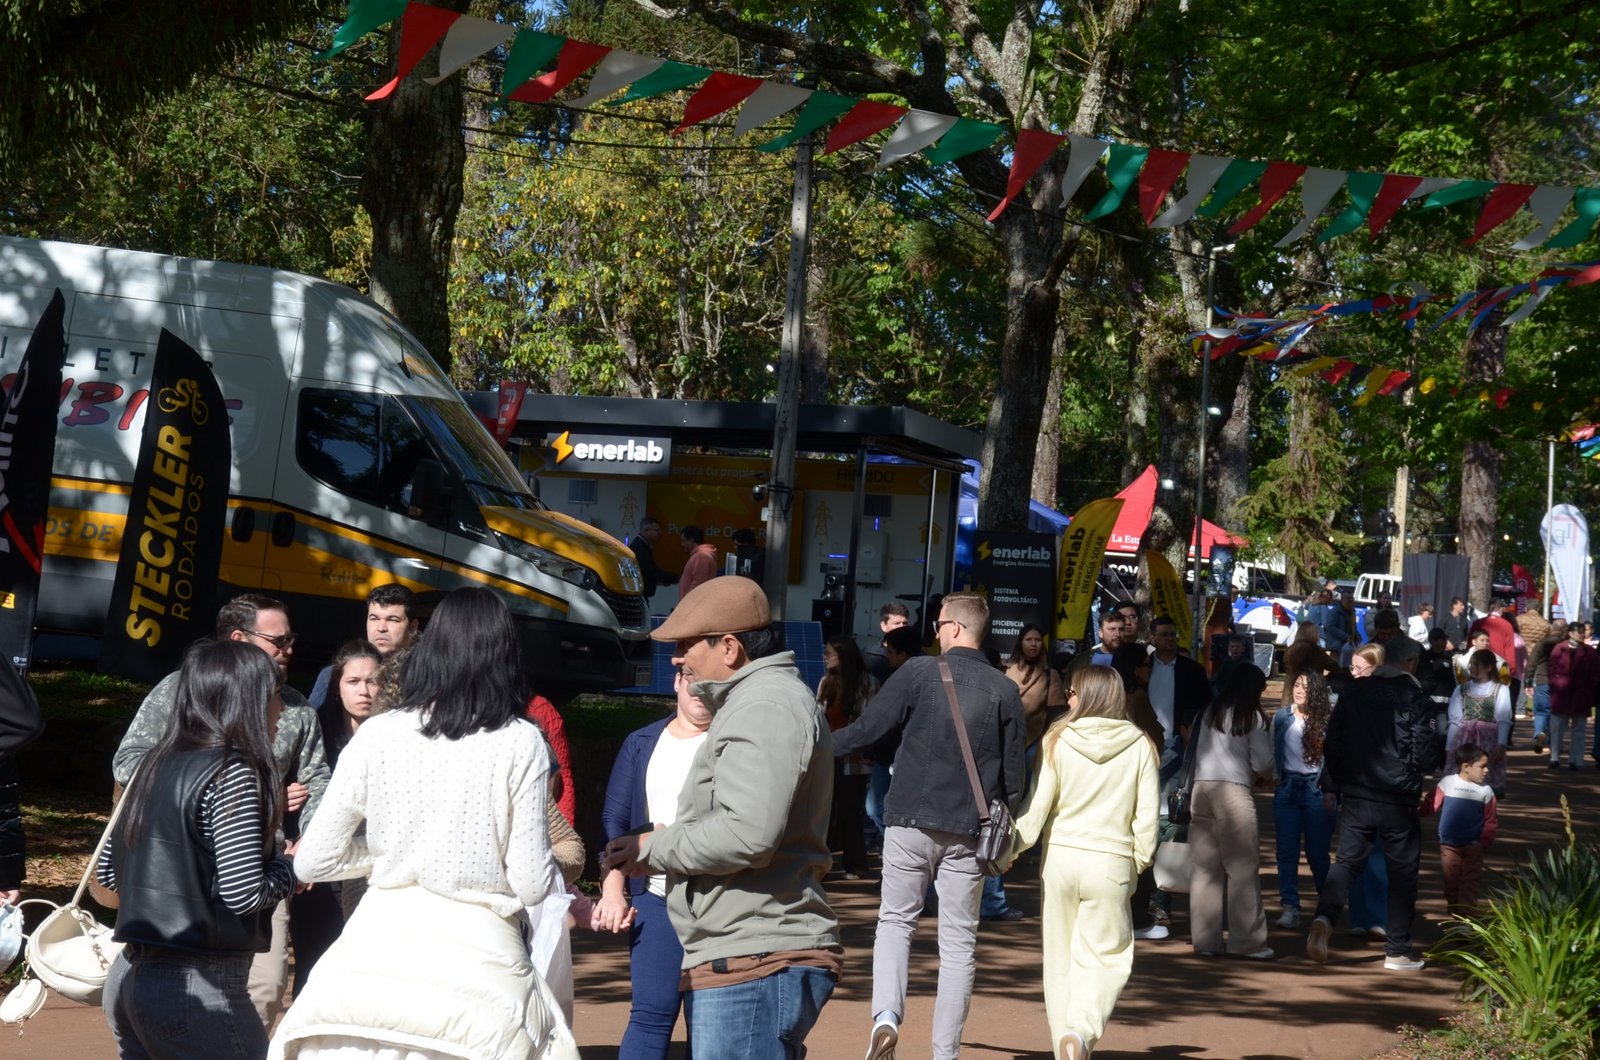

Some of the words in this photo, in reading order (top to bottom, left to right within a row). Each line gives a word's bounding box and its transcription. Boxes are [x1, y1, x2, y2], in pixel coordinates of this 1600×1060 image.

[573, 439, 664, 463] enerlab
[80, 522, 114, 543] DE
[125, 425, 192, 647] STECKLER
[1111, 534, 1123, 544] La
[171, 474, 204, 622] RODADOS
[992, 546, 1051, 561] enerlab
[992, 559, 1017, 568] Energías
[1017, 560, 1051, 569] Renovables
[1060, 527, 1086, 605] enerlab
[1081, 560, 1097, 594] ENERGÍA
[1091, 535, 1106, 560] SOLAR
[993, 587, 1019, 595] SISTEMA
[992, 619, 1025, 628] EFICIENCIA
